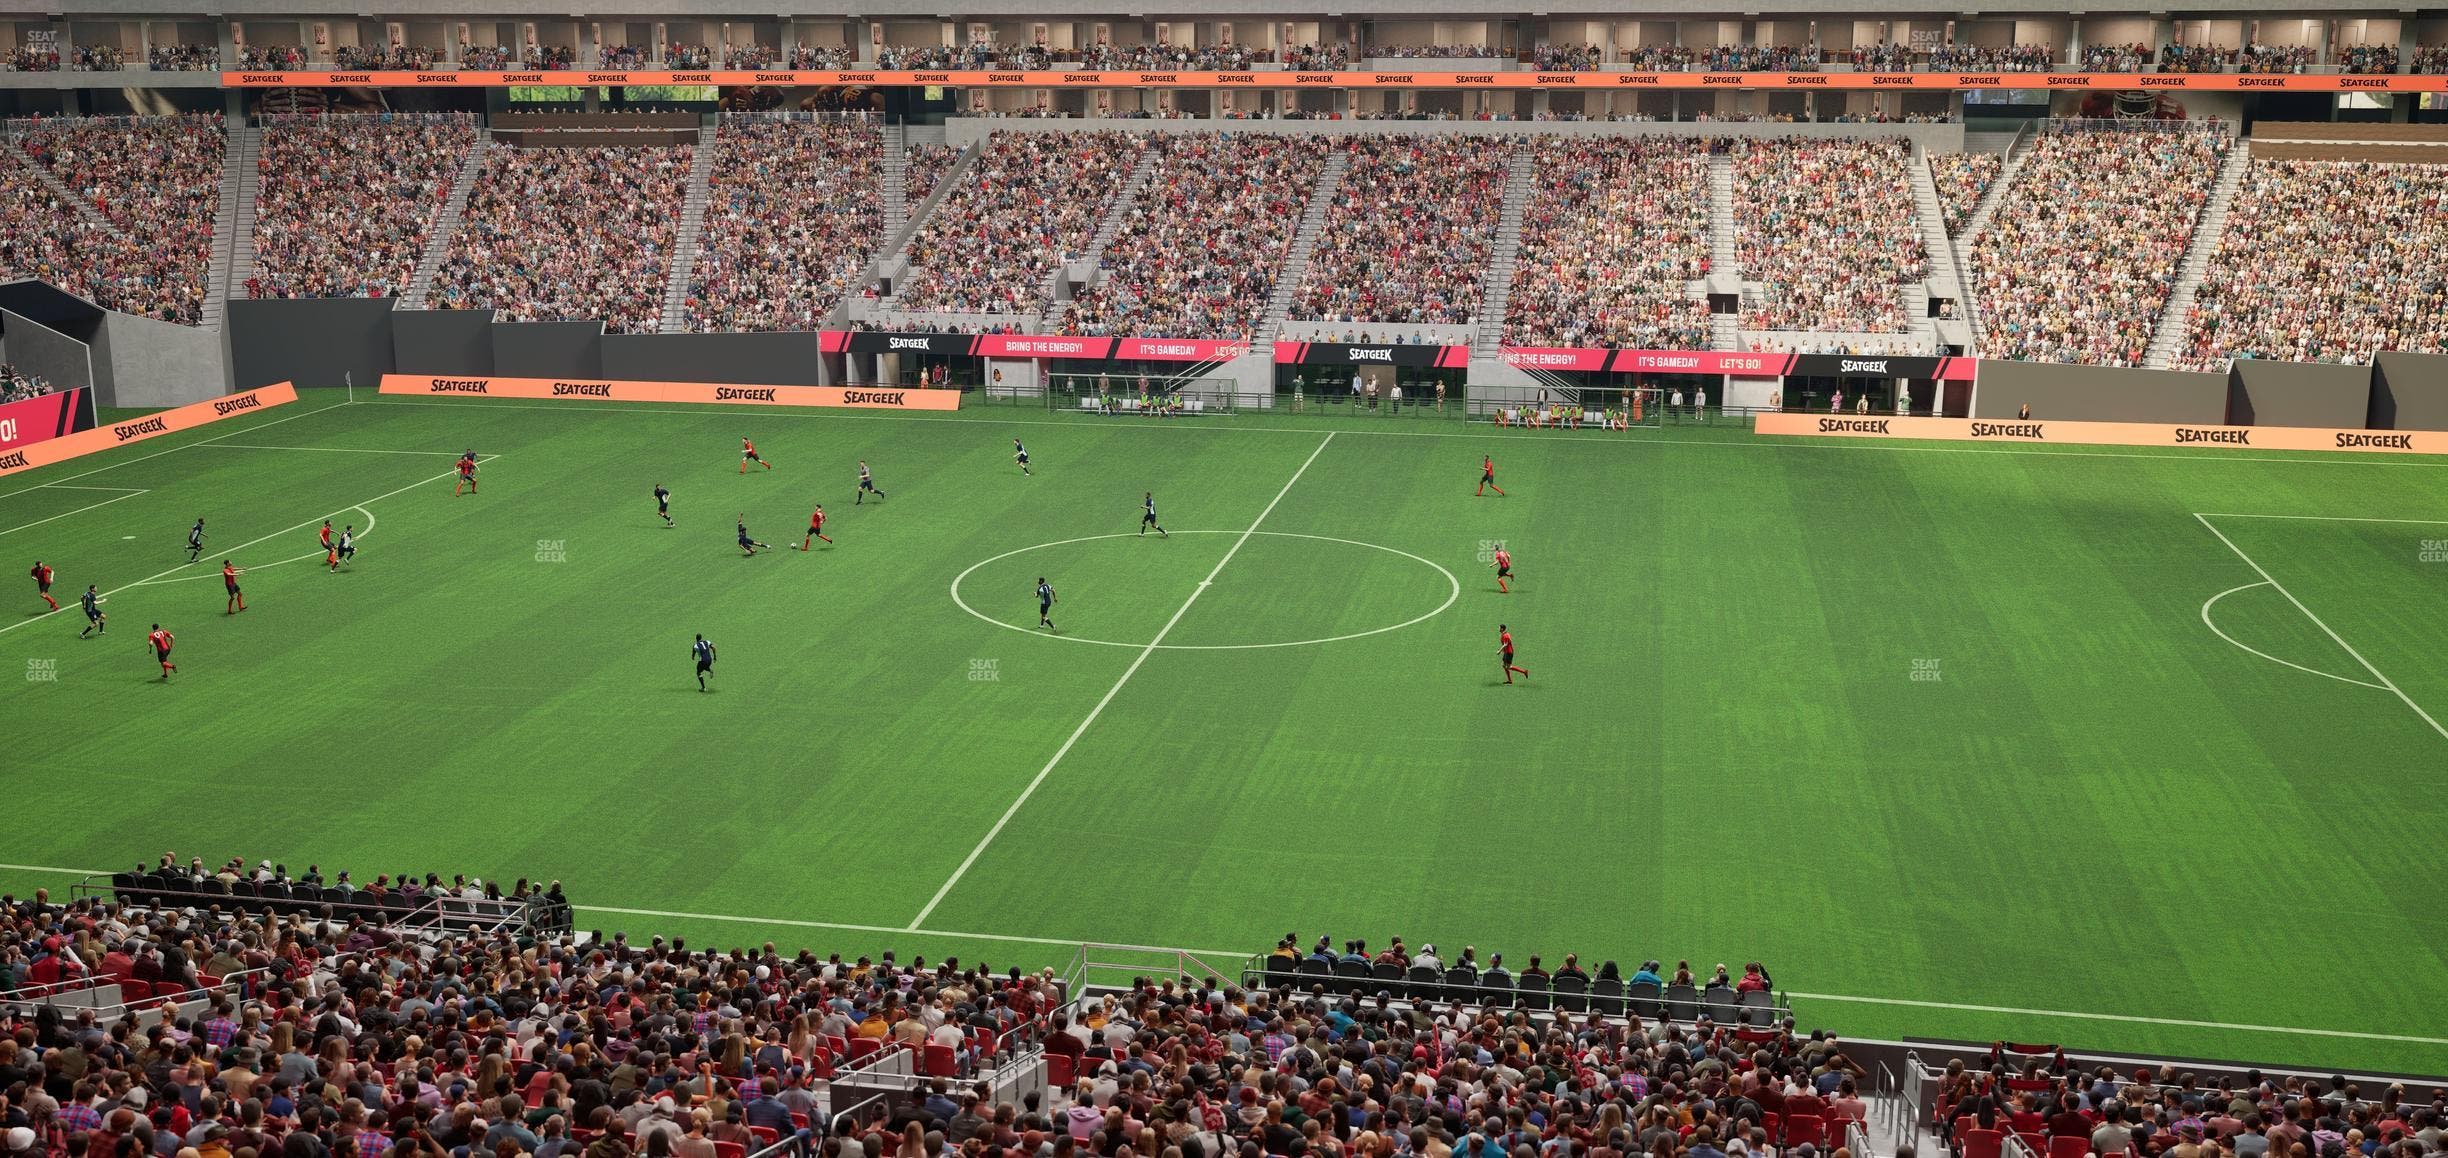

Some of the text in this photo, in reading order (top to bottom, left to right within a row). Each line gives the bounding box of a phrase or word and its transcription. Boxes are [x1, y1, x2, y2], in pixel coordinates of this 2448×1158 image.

[243, 75, 283, 83] SEATGEEK
[330, 74, 371, 82] SEATGEEK
[417, 74, 457, 82] SEATGEEK
[503, 74, 542, 82] SEATGEEK
[588, 74, 627, 82] SEATGEEK
[673, 74, 711, 82] SEATGEEK
[756, 73, 794, 81] SEATGEEK
[839, 73, 875, 81] SEATGEEK
[915, 73, 948, 81] SEATGEEK
[989, 74, 1023, 82] SEATGEEK
[1065, 74, 1099, 82] SEATGEEK
[1141, 74, 1176, 82] SEATGEEK
[1218, 75, 1254, 83] SEATGEEK
[1297, 74, 1333, 82] SEATGEEK
[1376, 75, 1412, 83] SEATGEEK
[1456, 75, 1493, 83] SEATGEEK
[1538, 75, 1575, 83] SEATGEEK
[1620, 75, 1657, 83] SEATGEEK
[1703, 76, 1742, 84] SEATGEEK
[1788, 76, 1826, 84] SEATGEEK
[1873, 76, 1912, 84] SEATGEEK
[1960, 76, 2000, 84] SEATGEEK
[2048, 77, 2089, 85] SEATGEEK
[2141, 77, 2185, 85] SEATGEEK
[2239, 78, 2284, 86] SEATGEEK
[2340, 79, 2389, 87] SEATGEEK
[890, 337, 929, 349] SEATGEEK
[1006, 341, 1083, 353] BRING THE ENERGY!
[1140, 344, 1196, 356] IT'S GAMEDAY
[1350, 348, 1392, 361] SEATGEEK
[1539, 354, 1576, 365] ENERGY!
[1638, 356, 1700, 368] IT'S GAMEDAY
[1719, 358, 1761, 370] LET'S GO!
[1840, 359, 1888, 374] SEATGEEK
[431, 379, 489, 394] SEATGEEK
[552, 382, 611, 397] SEATGEEK
[716, 387, 776, 402] SEATGEEK
[843, 391, 905, 406] SEATGEEK
[213, 393, 261, 416] SEATGEEK
[114, 416, 168, 442] SEATGEEK
[1818, 418, 1890, 434] SEATGEEK
[1971, 422, 2044, 439] SEATGEEK
[2175, 428, 2250, 445] SEATGEEK
[2335, 432, 2413, 450] SEATGEEK
